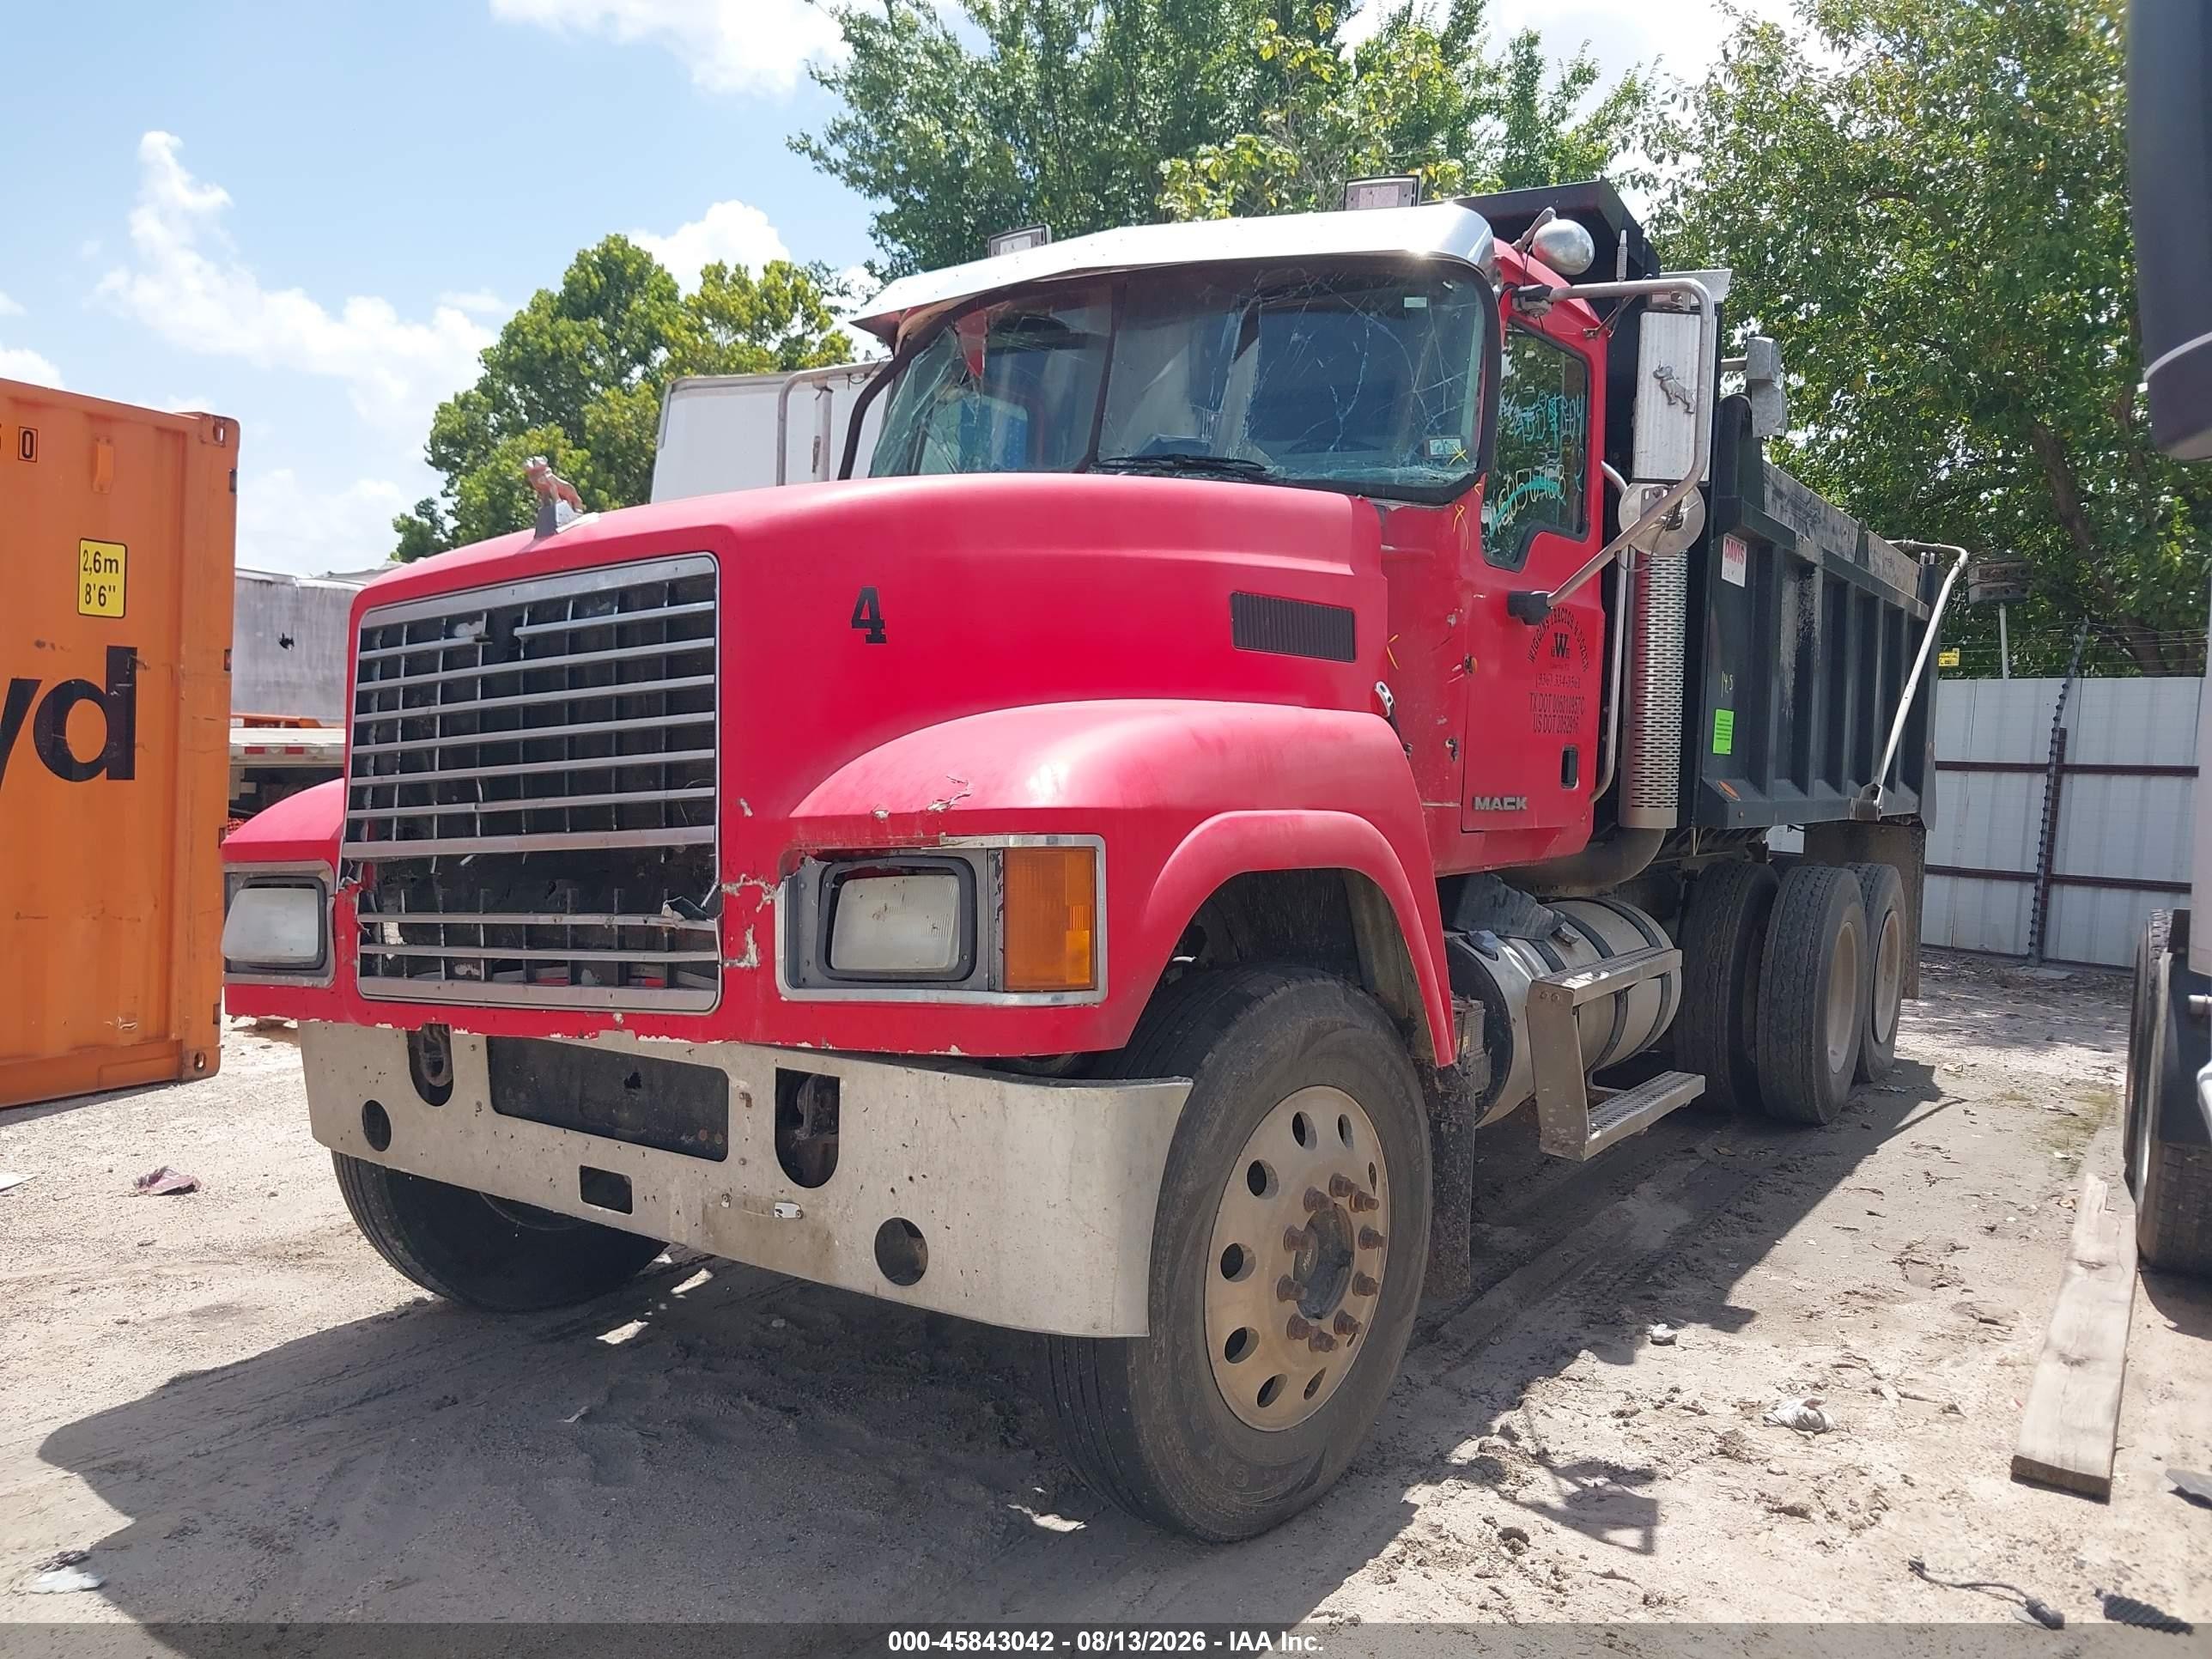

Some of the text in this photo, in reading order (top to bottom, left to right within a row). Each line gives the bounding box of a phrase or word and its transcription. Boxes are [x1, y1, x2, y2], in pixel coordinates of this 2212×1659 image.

[1725, 538, 1745, 566] DAVIS
[851, 586, 887, 644] 4
[1529, 692, 1537, 713] TX
[1539, 693, 1551, 713] DOT
[1533, 714, 1542, 732] US
[1543, 714, 1556, 733] DOT
[1474, 796, 1528, 811] MACK
